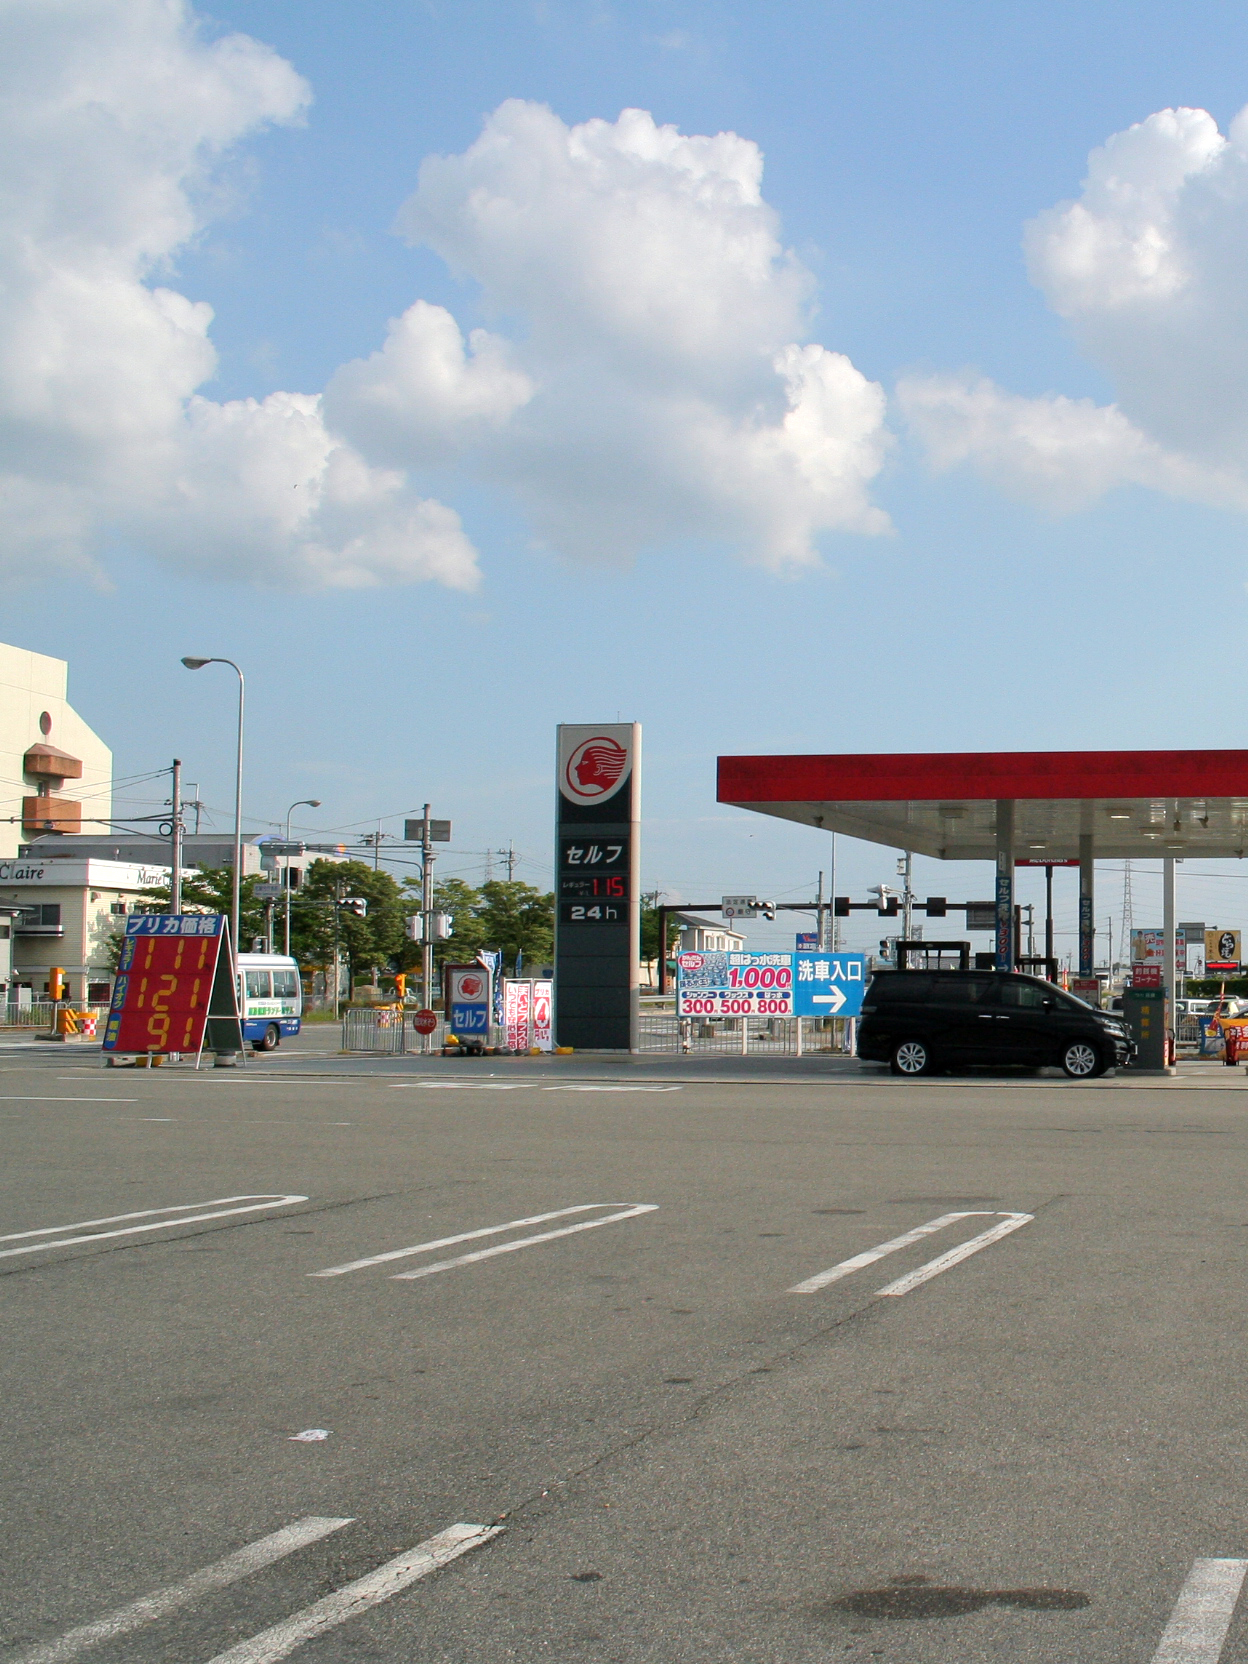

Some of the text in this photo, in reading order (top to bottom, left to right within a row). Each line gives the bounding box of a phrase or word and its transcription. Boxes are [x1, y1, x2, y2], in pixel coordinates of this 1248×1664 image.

[566, 845, 623, 865] セルフ
[137, 869, 162, 886] Marie
[562, 876, 625, 897] レギュラー 115
[129, 916, 217, 935] プリカ価格
[144, 938, 209, 970] 111
[798, 960, 862, 981] 洗車入口
[137, 974, 201, 1012] 121
[534, 988, 550, 996] プリカ
[453, 1009, 488, 1029] セルフ
[146, 1013, 194, 1051] 91
